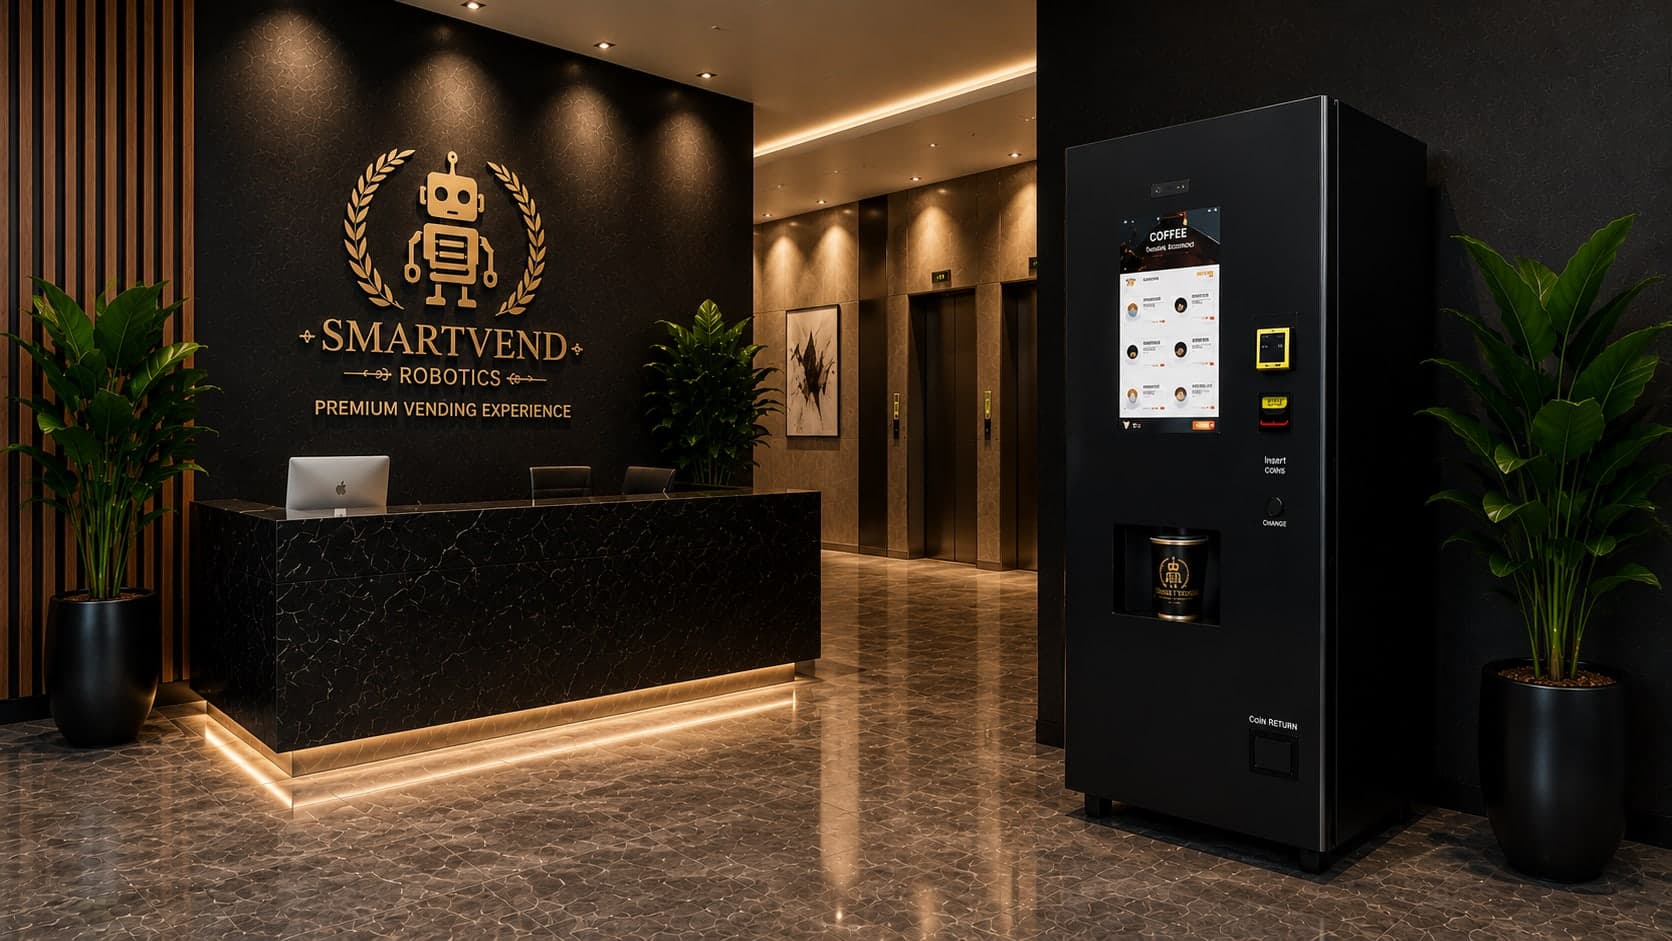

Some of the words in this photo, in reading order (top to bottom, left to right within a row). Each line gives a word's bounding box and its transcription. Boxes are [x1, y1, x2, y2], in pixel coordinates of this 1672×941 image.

[1149, 227, 1187, 242] COFFEE
[321, 318, 568, 361] SMARTVEND
[400, 367, 501, 387] ROBOTICS
[314, 400, 398, 416] PREMIUM
[403, 402, 477, 418] VENDING
[482, 403, 572, 418] EXPERIENCE
